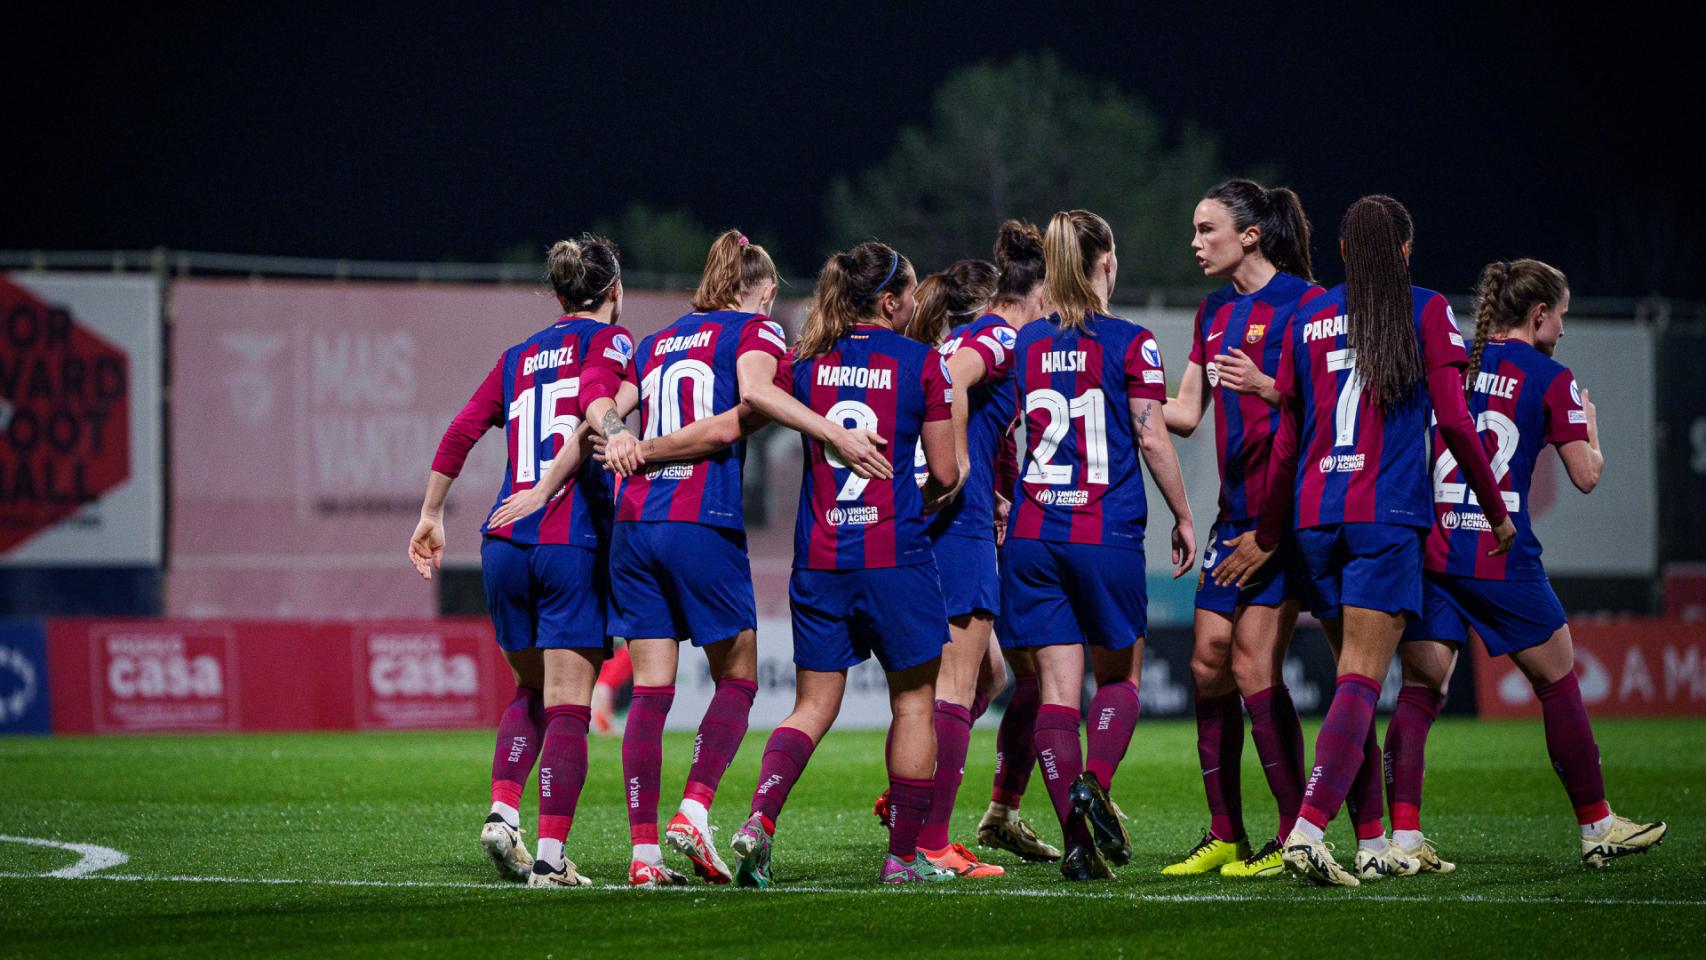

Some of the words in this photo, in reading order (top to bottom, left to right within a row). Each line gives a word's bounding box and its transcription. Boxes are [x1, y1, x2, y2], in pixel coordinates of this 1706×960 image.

[655, 330, 713, 356] GRAHAM
[523, 344, 574, 376] BRONZE
[1041, 350, 1087, 373] WALSH
[817, 364, 892, 390] MARIONA
[641, 359, 716, 441] 10
[1326, 347, 1368, 446] 7
[508, 376, 580, 483] 15
[1023, 388, 1109, 485] 21
[825, 400, 878, 501] 9
[1337, 453, 1365, 462] UNHCR
[1337, 460, 1364, 469] ACNUR
[0, 457, 99, 504] ALL
[662, 469, 693, 477] ACNUR
[1056, 496, 1087, 504] ACNUR
[1057, 490, 1088, 498] UNHCR
[847, 506, 878, 515] UNHCR
[1461, 512, 1487, 521] UNHC
[109, 655, 222, 698] casa
[369, 655, 478, 697] casa
[507, 736, 527, 763] BARÇA
[1041, 748, 1060, 780] BARÇA
[541, 767, 553, 797] BARÇA
[630, 776, 640, 809] BARÇA
[1305, 766, 1323, 797] BARÇA
